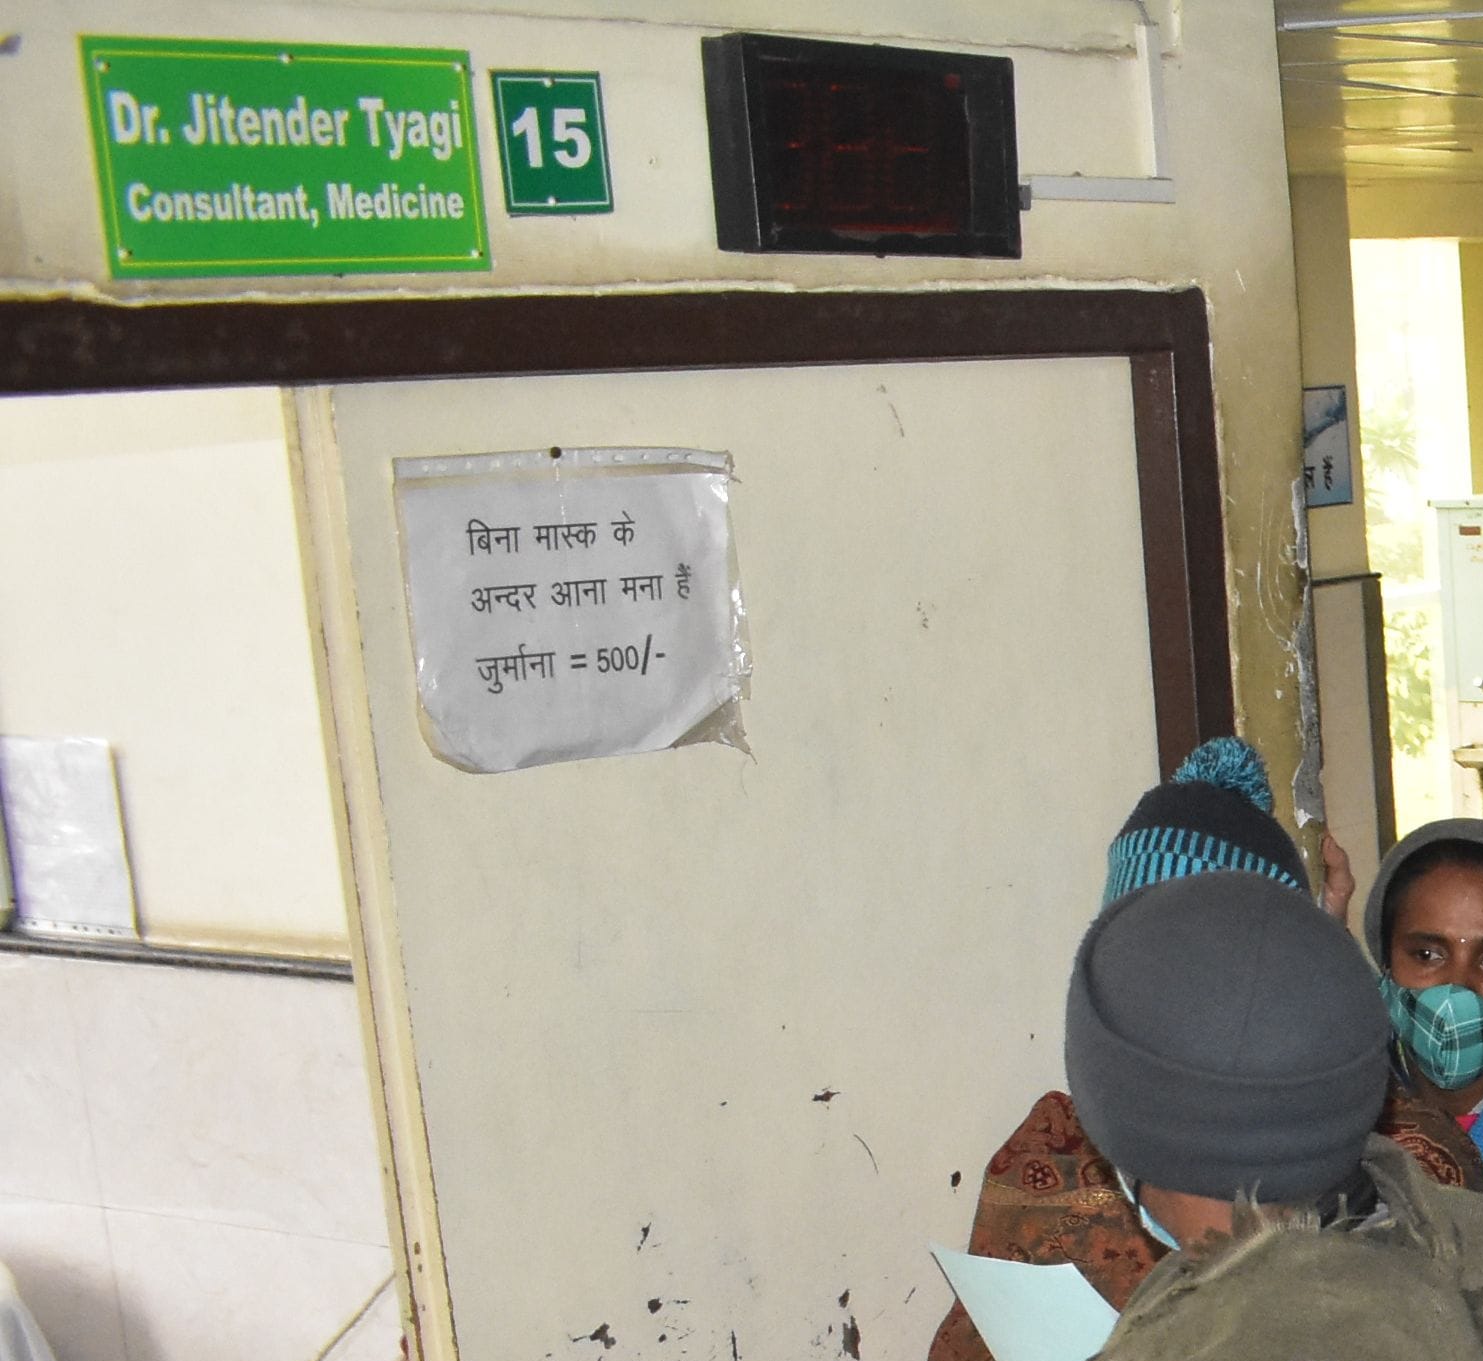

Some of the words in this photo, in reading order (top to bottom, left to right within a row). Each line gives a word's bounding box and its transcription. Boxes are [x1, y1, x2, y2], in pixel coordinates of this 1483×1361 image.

[108, 90, 171, 146] Dr.
[183, 92, 349, 148] Jitender
[358, 98, 464, 161] Tyagi
[511, 106, 592, 169] 15
[126, 181, 320, 228] Consultant,
[326, 182, 465, 221] Medicine
[466, 519, 520, 555] बिना
[533, 521, 597, 551] मास्क
[611, 511, 635, 546] के
[471, 583, 537, 614] अन्दर
[551, 578, 607, 608] आना
[619, 574, 664, 602] मना
[474, 643, 555, 694] जुर्माना
[570, 653, 587, 670] =
[597, 633, 666, 675] 500/-
